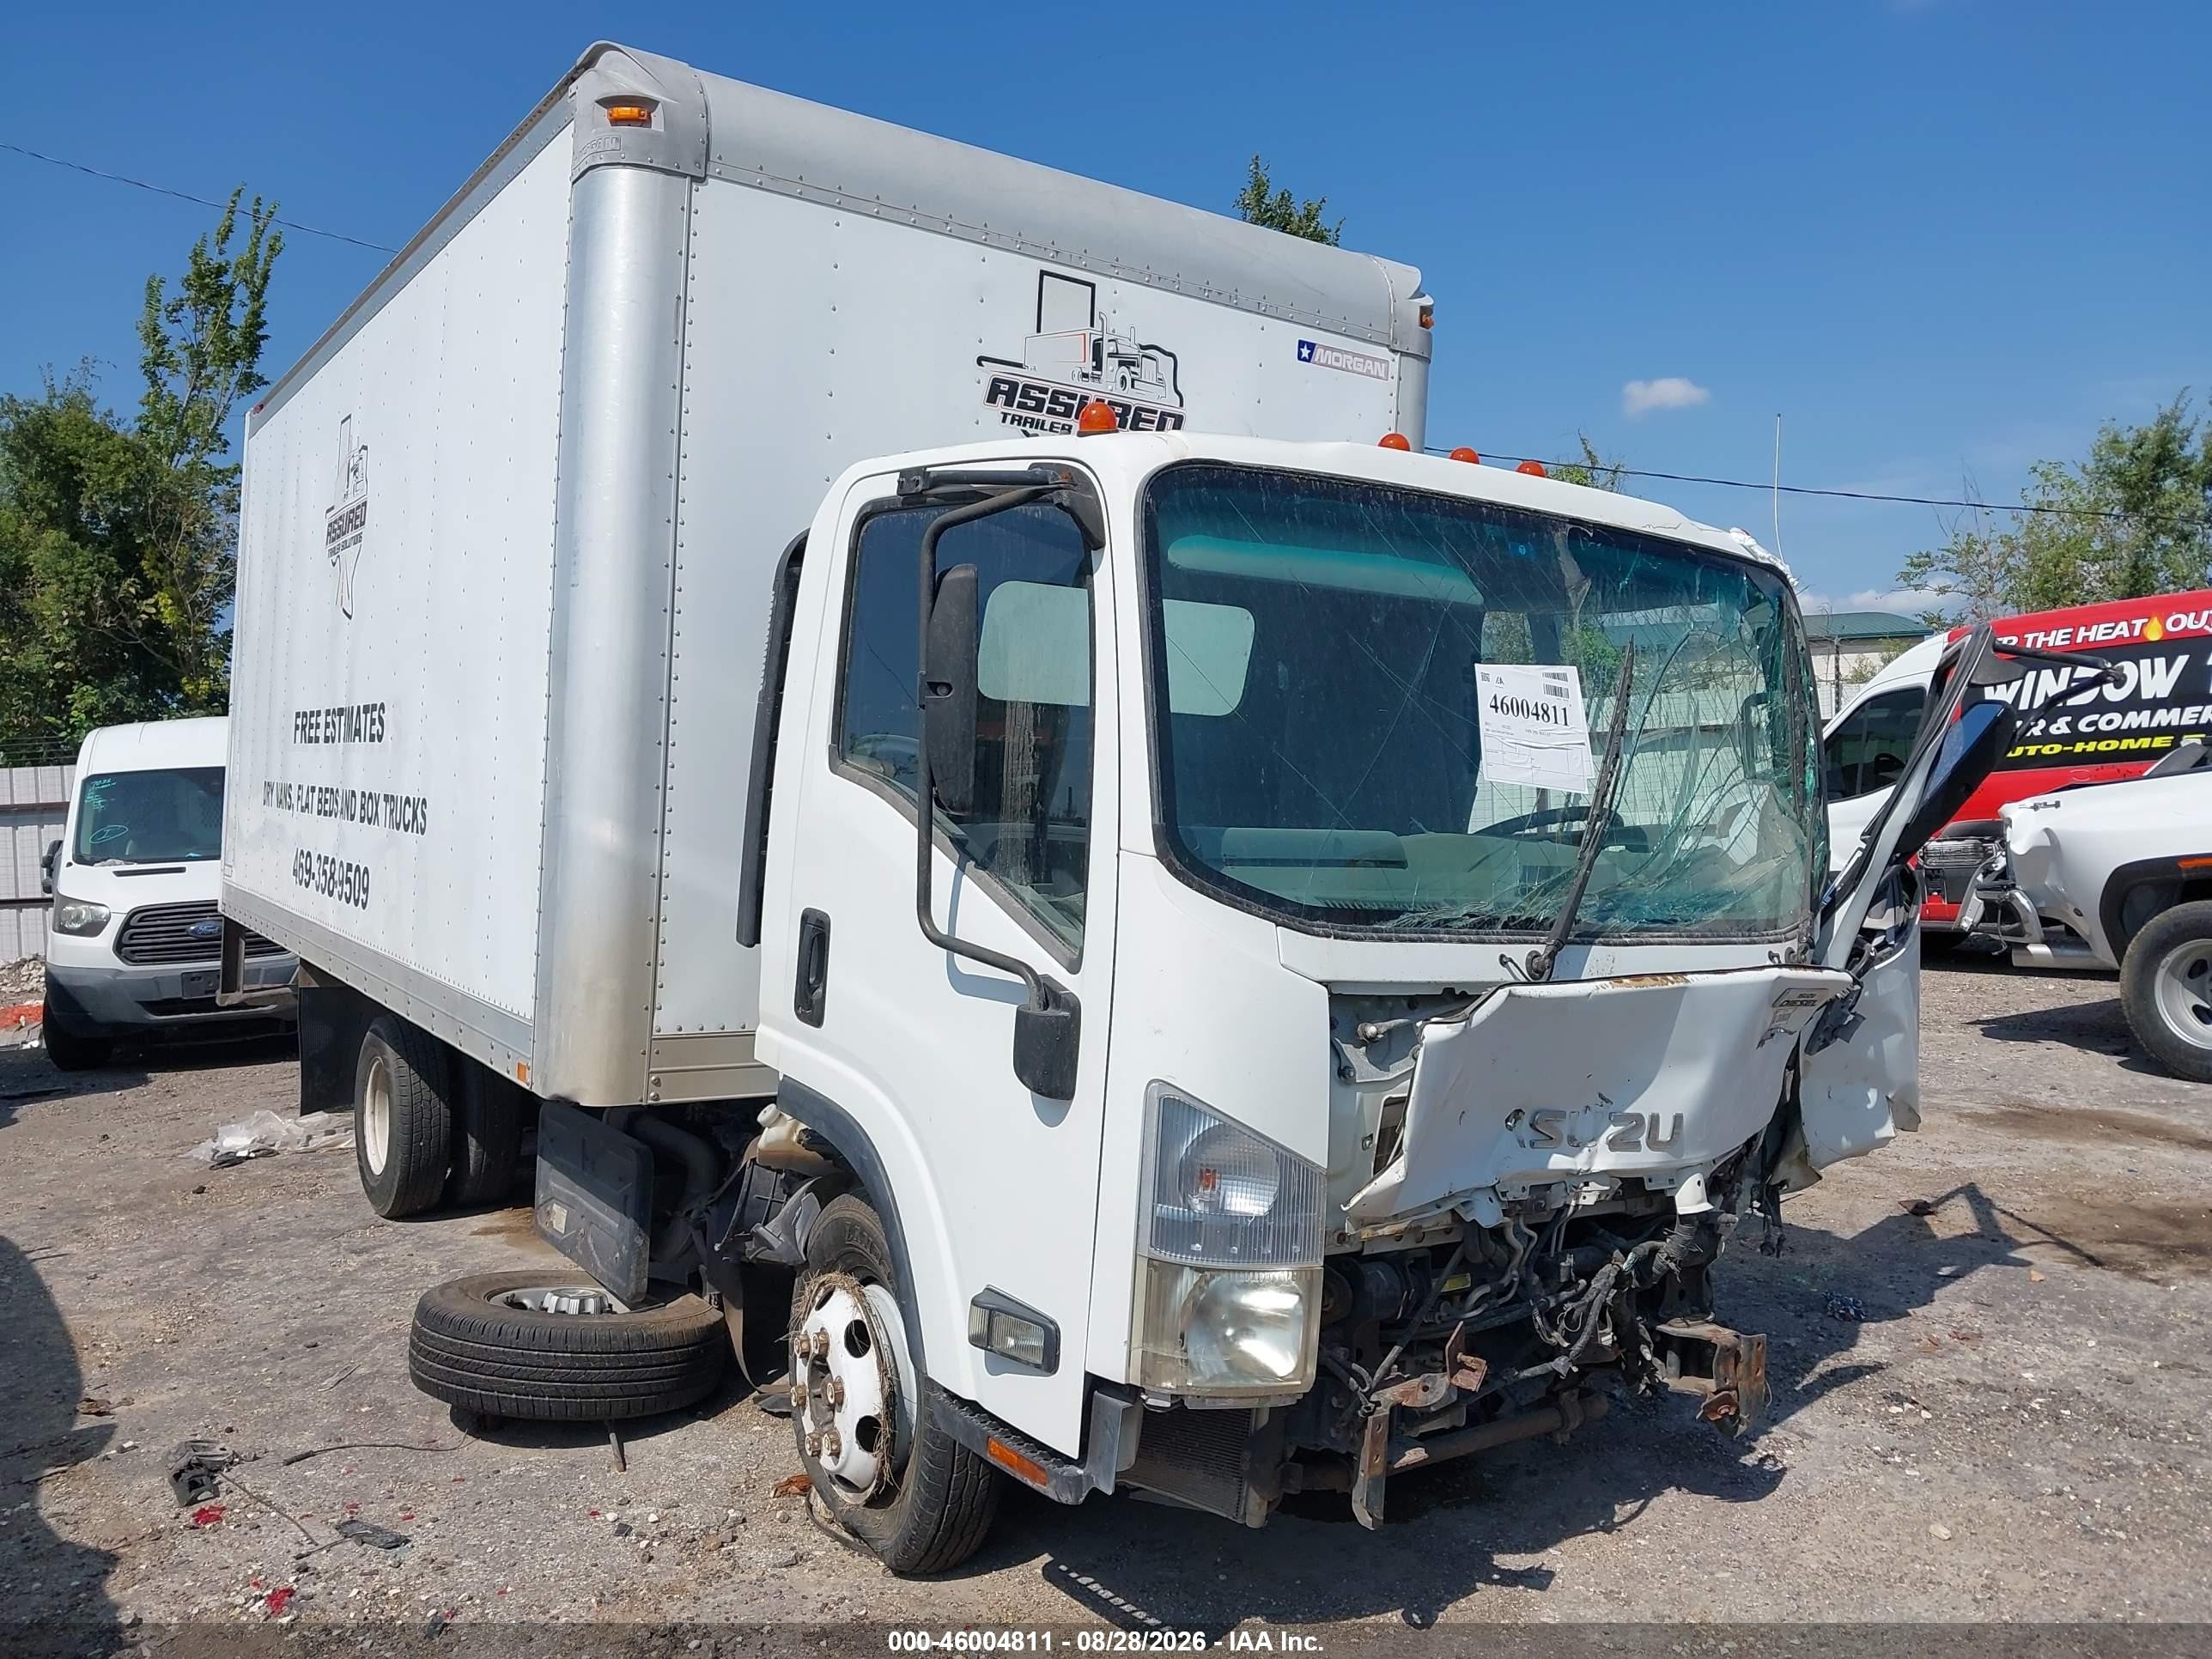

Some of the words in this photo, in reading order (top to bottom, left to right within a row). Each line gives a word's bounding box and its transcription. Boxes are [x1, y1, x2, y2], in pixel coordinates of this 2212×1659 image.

[1314, 347, 1389, 379] MORGAN
[325, 500, 368, 546] ASSURED
[2023, 628, 2074, 649] THE
[2075, 618, 2148, 644] HEAT
[294, 709, 322, 744] FREE
[324, 702, 386, 744] ESTIMATES
[1489, 693, 1570, 727] 46004811
[2049, 715, 2073, 735] &
[2006, 735, 2174, 757] UTO-HOME
[263, 781, 275, 807] DRY
[296, 784, 316, 815] FLAT
[317, 786, 340, 818] BEDS
[338, 788, 357, 822] AND
[359, 791, 381, 827] BOX
[383, 793, 428, 836] TRUCKS
[292, 847, 370, 911] 469-358-9509
